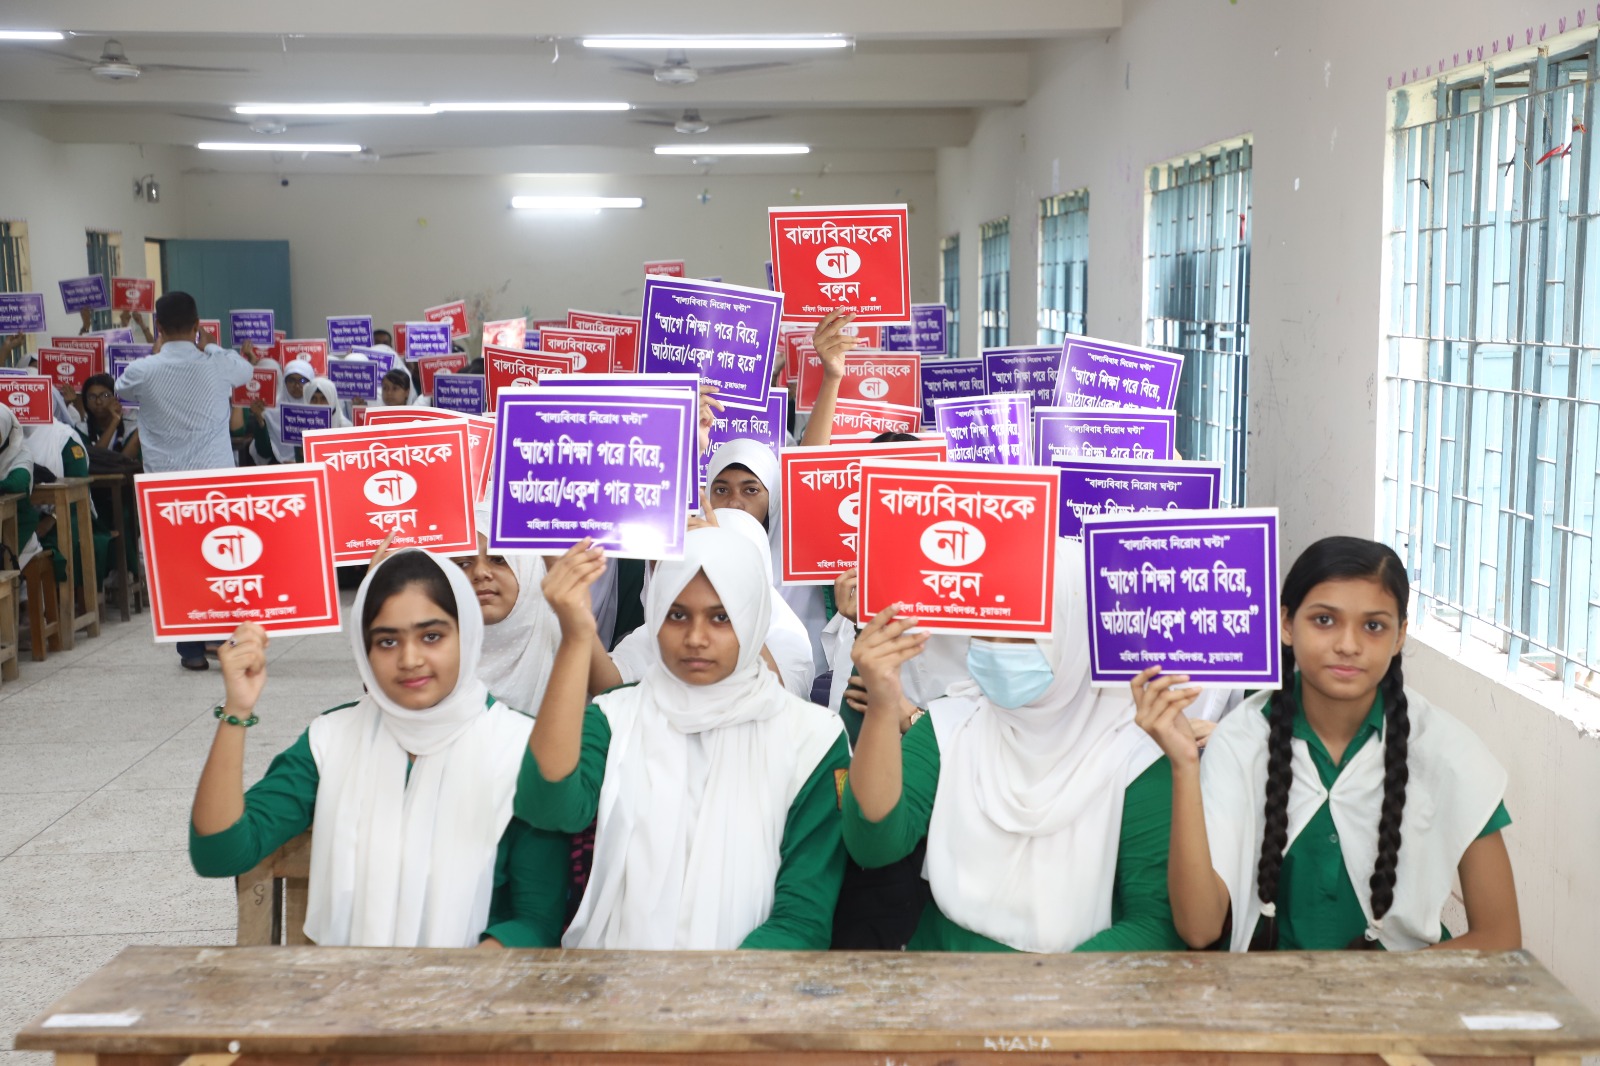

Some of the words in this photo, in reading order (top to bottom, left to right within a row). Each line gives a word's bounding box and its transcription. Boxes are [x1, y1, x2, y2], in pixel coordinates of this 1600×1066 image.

[783, 221, 893, 245] বাল্যবিবাহকে
[825, 250, 849, 275] না
[818, 281, 860, 303] বলুন
[547, 337, 607, 354] বাল্যবিবাহকে
[655, 313, 683, 334] “আগে
[685, 314, 711, 338] শিক্ষা
[714, 322, 734, 341] পরে
[736, 321, 760, 349] বিয়ে,
[651, 337, 714, 370] আঠারো/একুশ
[717, 348, 735, 369] পার
[737, 353, 762, 374] হয়ে”
[865, 380, 881, 396] না
[991, 369, 1012, 384] “আগে
[1013, 367, 1031, 384] শিক্ষা
[1032, 369, 1046, 383] পরে
[1071, 366, 1097, 387] “আগে
[1098, 370, 1120, 392] শিক্ষা
[1122, 377, 1140, 395] পরে
[1140, 377, 1161, 402] বিয়ে,
[731, 418, 748, 433] পরে
[750, 415, 772, 437] বিয়ে,
[833, 411, 910, 433] বাল্যবিবাহকে
[322, 442, 453, 471] বাল্যবিবাহকে
[512, 438, 553, 465] “আগে
[557, 434, 593, 466] শিক্ষা
[597, 441, 625, 466] পরে
[628, 437, 665, 473] বিয়ে,
[374, 474, 403, 501] না
[508, 471, 599, 511] আঠারো/একুশ
[603, 481, 629, 505] পার
[633, 480, 671, 508] হয়ে”
[1131, 478, 1157, 491] নিরোধ
[156, 491, 307, 525] বাল্যবিবাহকে
[878, 484, 1037, 522] বাল্যবিবাহকে
[366, 509, 418, 533] বলুন
[213, 532, 244, 564] না
[934, 526, 970, 561] না
[205, 574, 264, 605] বলুন
[919, 569, 984, 602] বলুন
[1100, 566, 1139, 594] “আগে
[1141, 562, 1176, 594] শিক্ষা
[1180, 566, 1209, 593] পরে
[1212, 560, 1252, 597] বিয়ে,
[1100, 601, 1186, 641] আঠারো/একুশ
[1189, 608, 1218, 635] পার
[1221, 605, 1260, 638] হয়ে”
